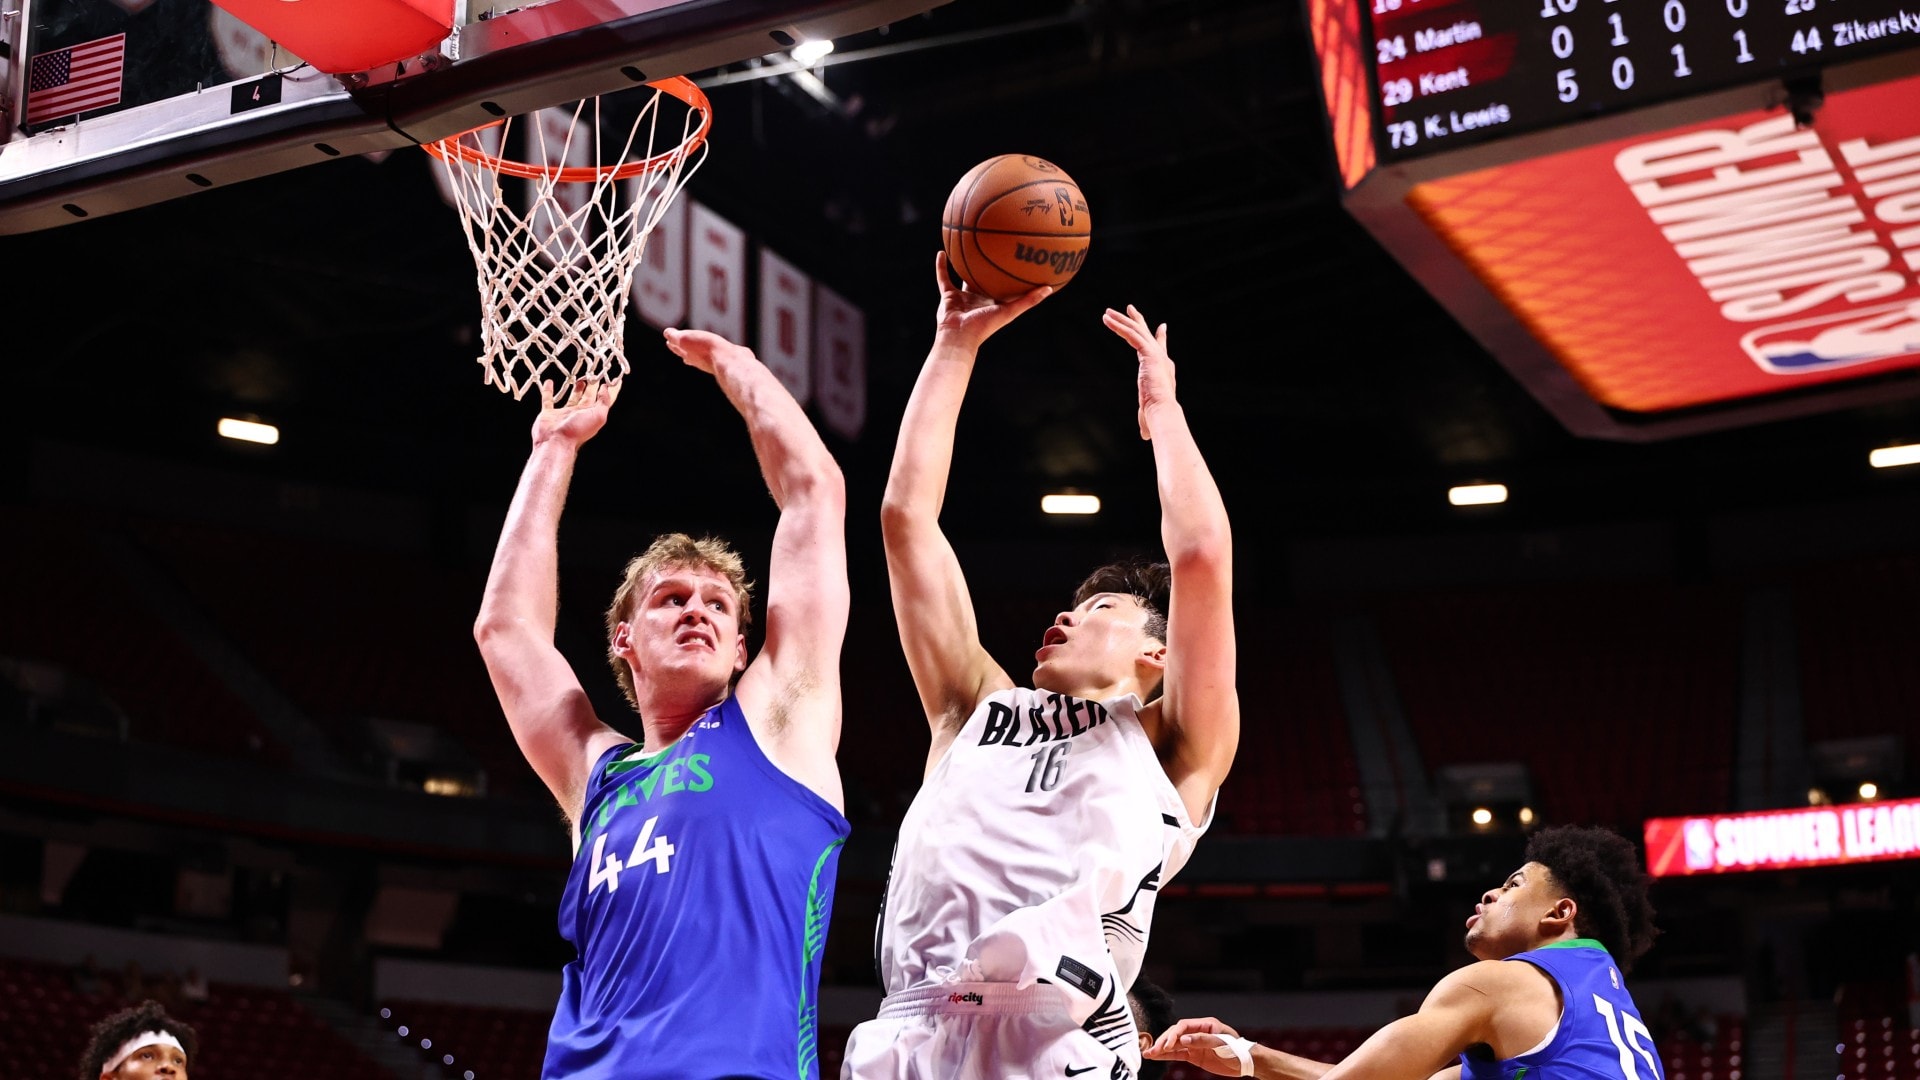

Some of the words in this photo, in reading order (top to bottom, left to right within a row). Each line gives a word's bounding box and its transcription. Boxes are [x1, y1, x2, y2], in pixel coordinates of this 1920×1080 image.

[1376, 34, 1408, 64] 24
[1414, 20, 1482, 52] Martin
[1382, 77, 1413, 107] 29
[1419, 66, 1470, 95] Kent
[1551, 25, 1574, 59] 0
[1608, 12, 1629, 46] 1
[1663, 0, 1687, 33] 0
[1791, 26, 1823, 54] 44
[252, 85, 261, 101] 4
[1386, 120, 1418, 149] 73
[1424, 114, 1448, 139] K.
[1450, 102, 1511, 133] Lewis
[1557, 68, 1579, 103] 5
[1612, 56, 1635, 90] 0
[1671, 43, 1692, 77] 1
[1733, 29, 1755, 64] 1
[1614, 113, 1906, 322] SUMMER
[978, 693, 1108, 747] BLAZER
[1025, 742, 1072, 793] 16
[589, 815, 675, 895] 44
[1714, 811, 1840, 865] SUMMER
[1593, 992, 1661, 1080] 15
